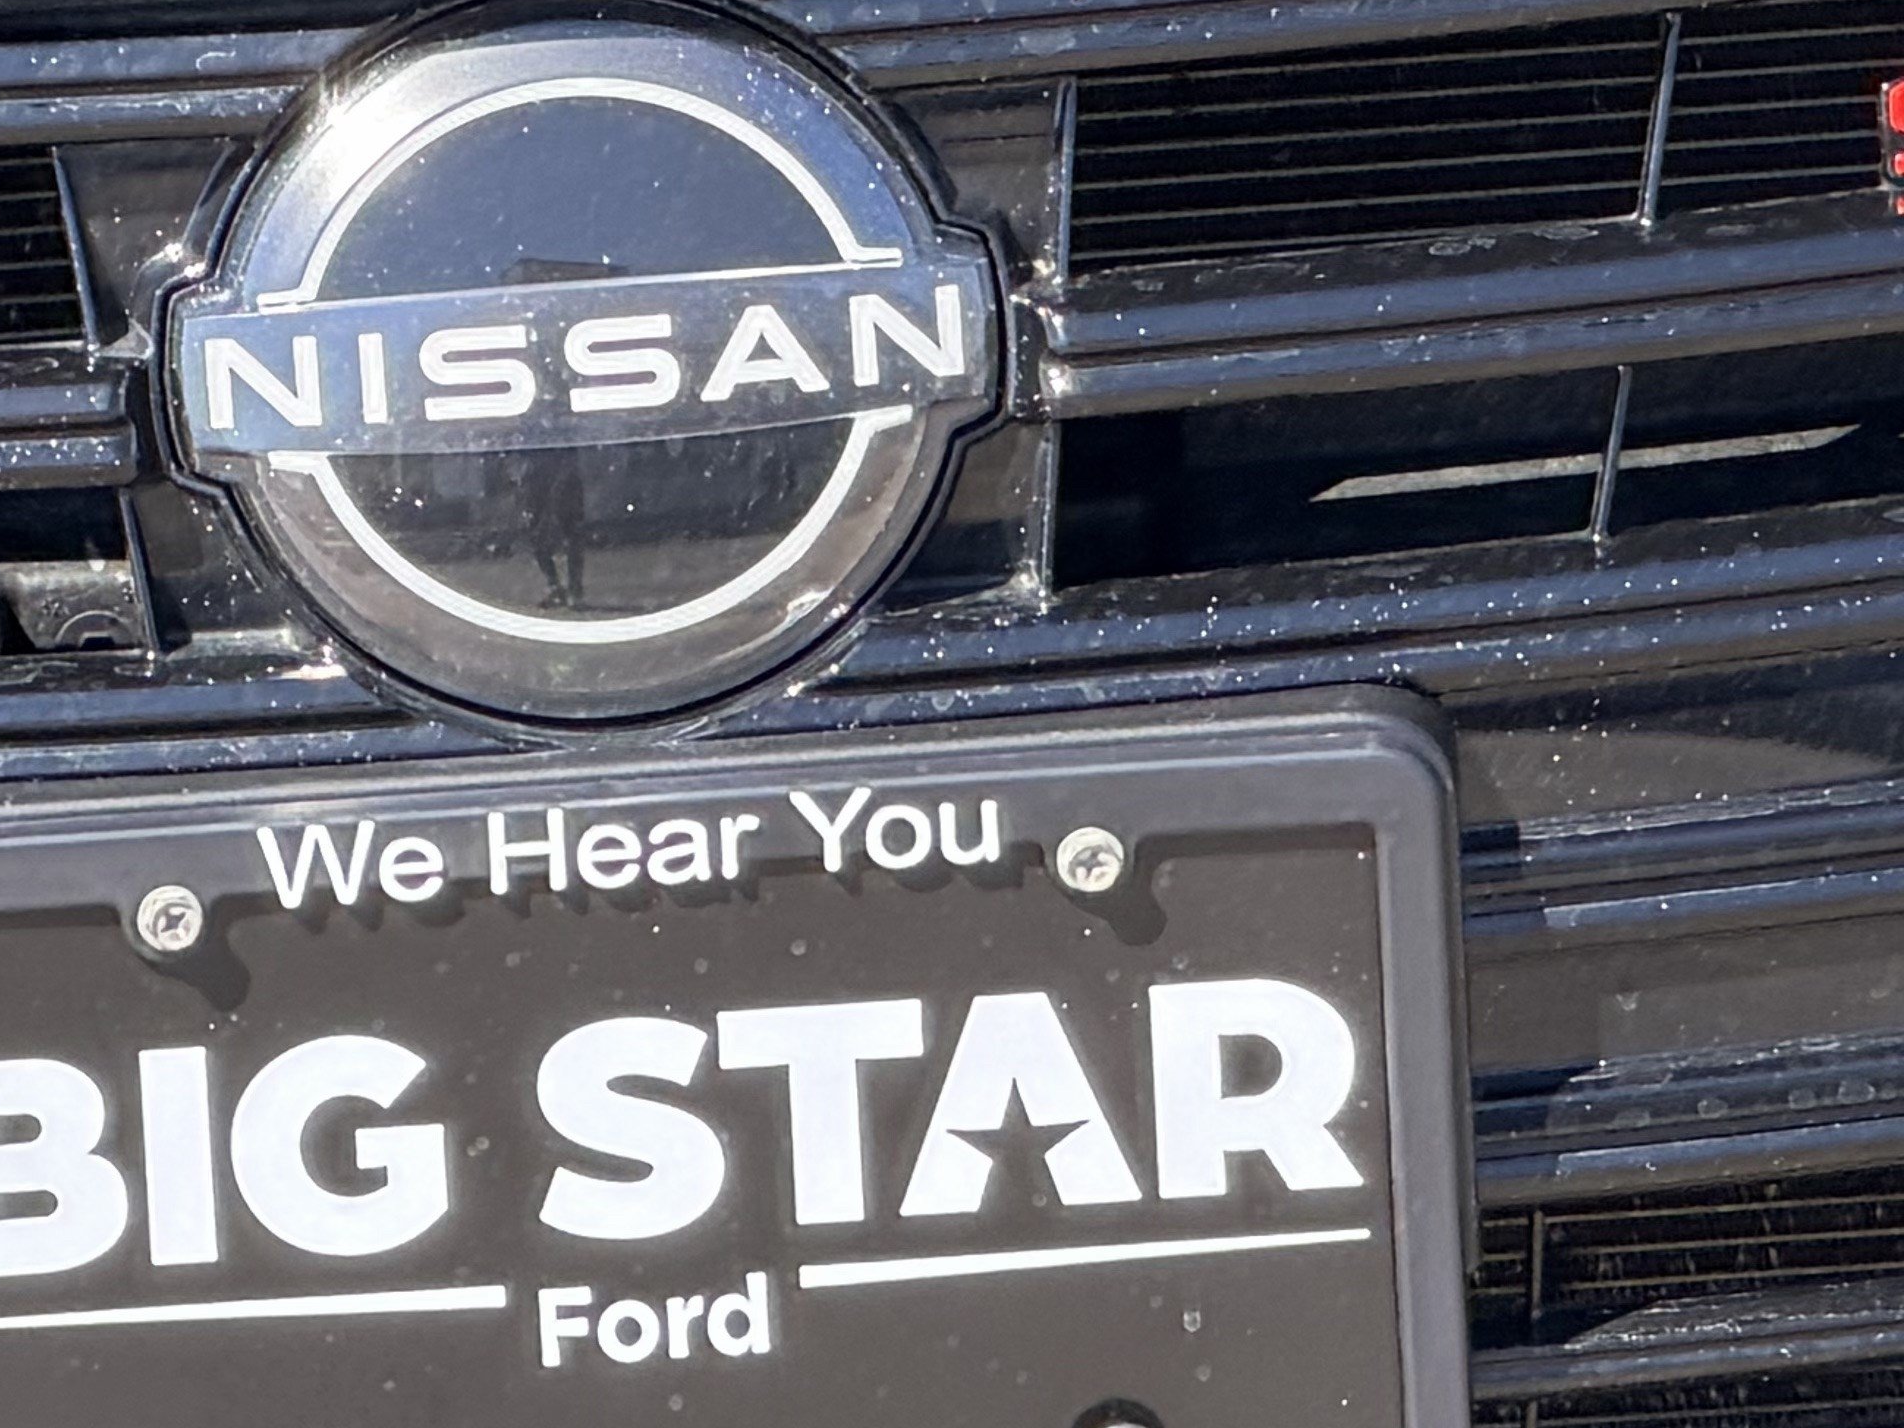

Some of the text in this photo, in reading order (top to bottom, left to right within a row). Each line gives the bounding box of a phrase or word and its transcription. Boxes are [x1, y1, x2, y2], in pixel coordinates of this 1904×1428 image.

[204, 285, 965, 430] NISSAN
[258, 784, 1003, 913] We Hear You
[537, 977, 1365, 1241] STAR
[537, 1269, 771, 1369] Ford
